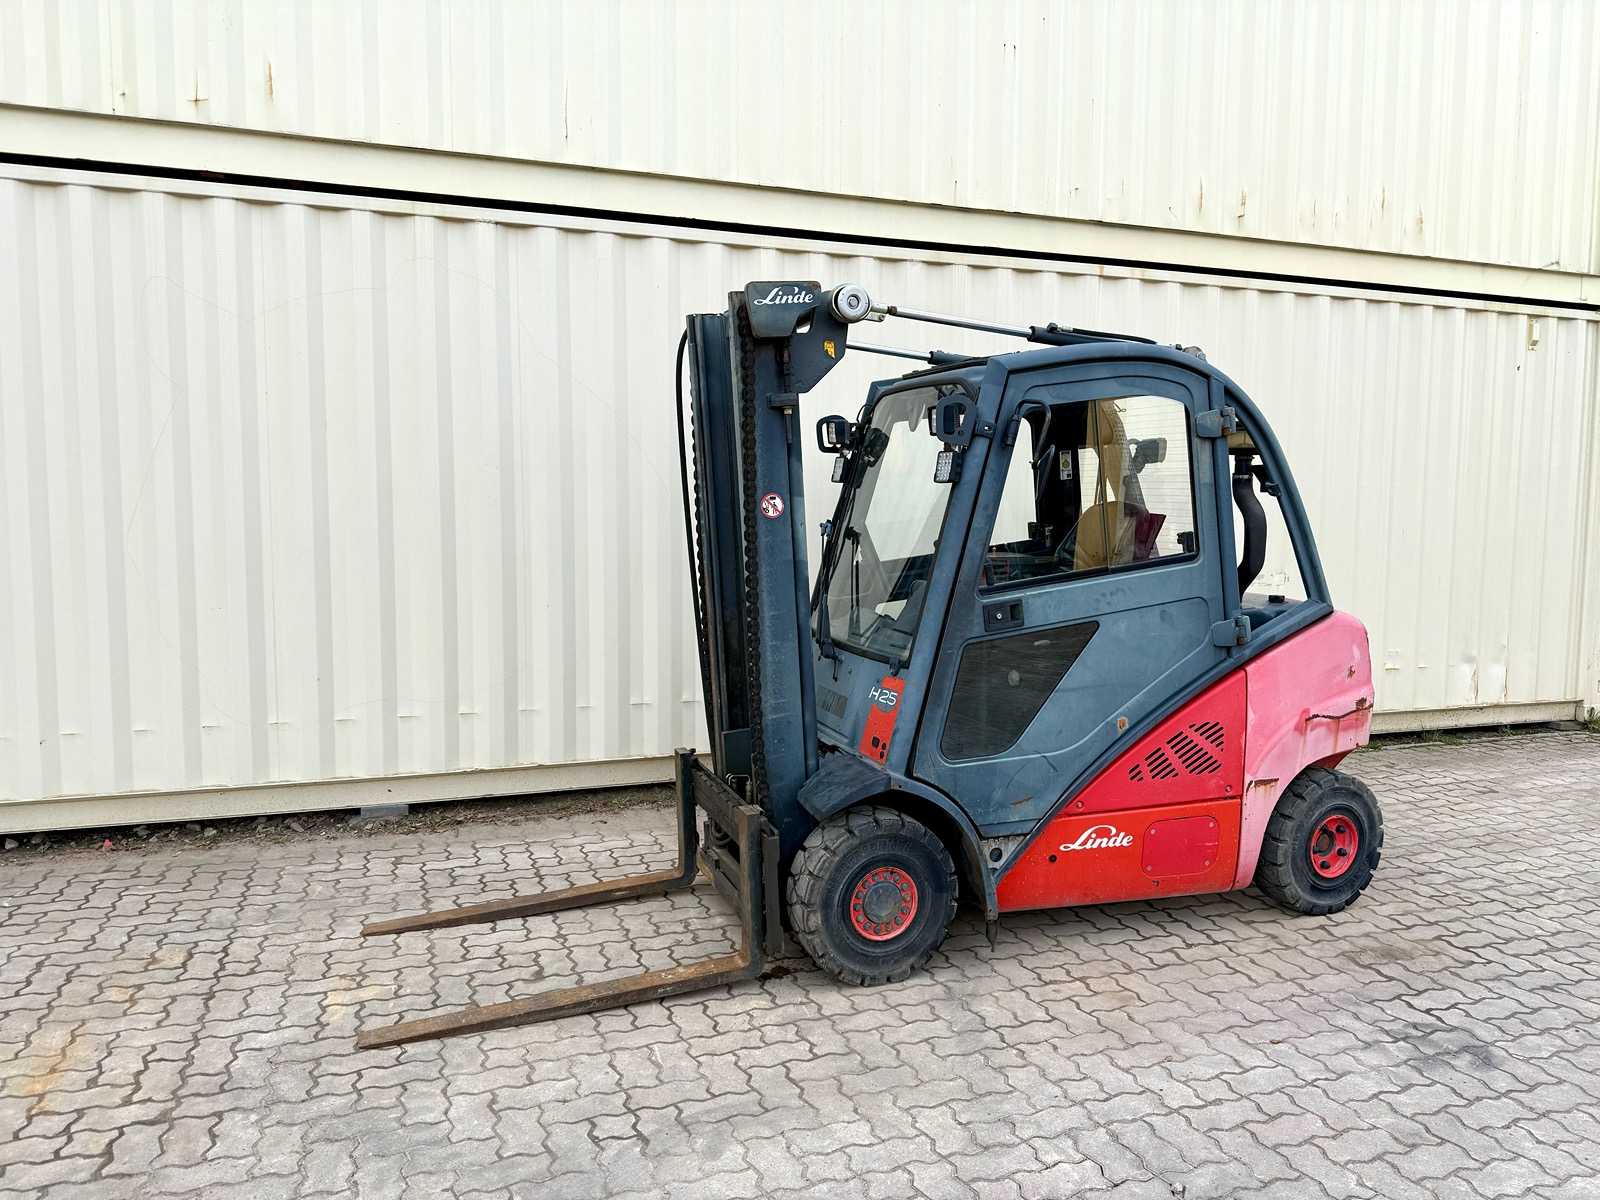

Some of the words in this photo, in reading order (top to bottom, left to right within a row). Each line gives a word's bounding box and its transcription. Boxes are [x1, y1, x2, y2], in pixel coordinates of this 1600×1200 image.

[753, 286, 814, 306] Linde
[868, 686, 898, 706] H25
[1059, 824, 1134, 852] Linde
